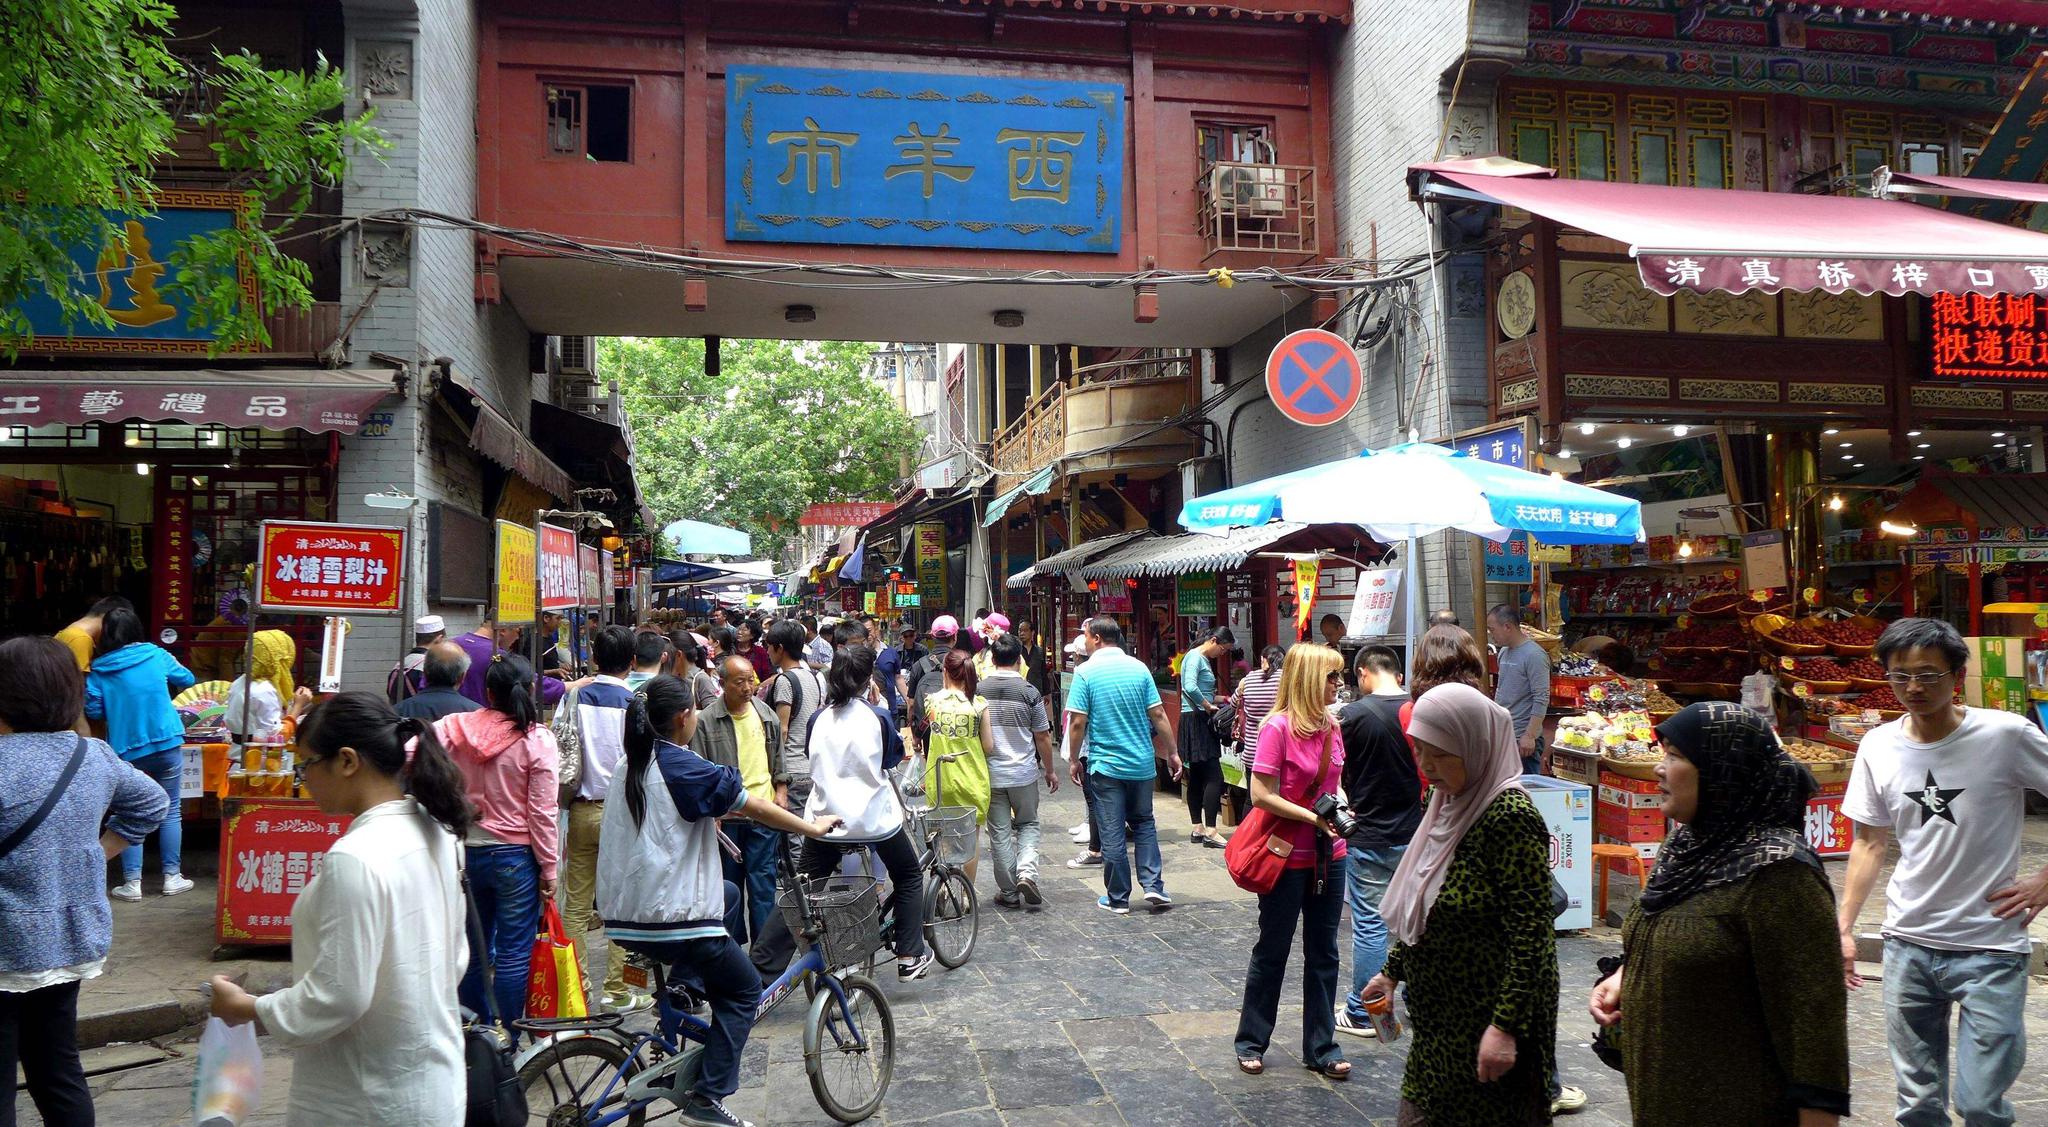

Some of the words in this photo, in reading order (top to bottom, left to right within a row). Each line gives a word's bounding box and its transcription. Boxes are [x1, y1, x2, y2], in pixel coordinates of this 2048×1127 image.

[1940, 292, 2048, 328] 银联刷
[367, 424, 391, 436] 206
[1515, 504, 1563, 523] 天天饮用
[1568, 510, 1619, 528] 益于健康
[295, 538, 309, 550] 清
[359, 541, 371, 553] 真
[1487, 540, 1527, 557] 桃酥
[275, 554, 388, 586] 冰糖雪梨汁
[255, 820, 270, 834] 清
[327, 822, 340, 835] 真
[1803, 803, 1836, 849] 桃
